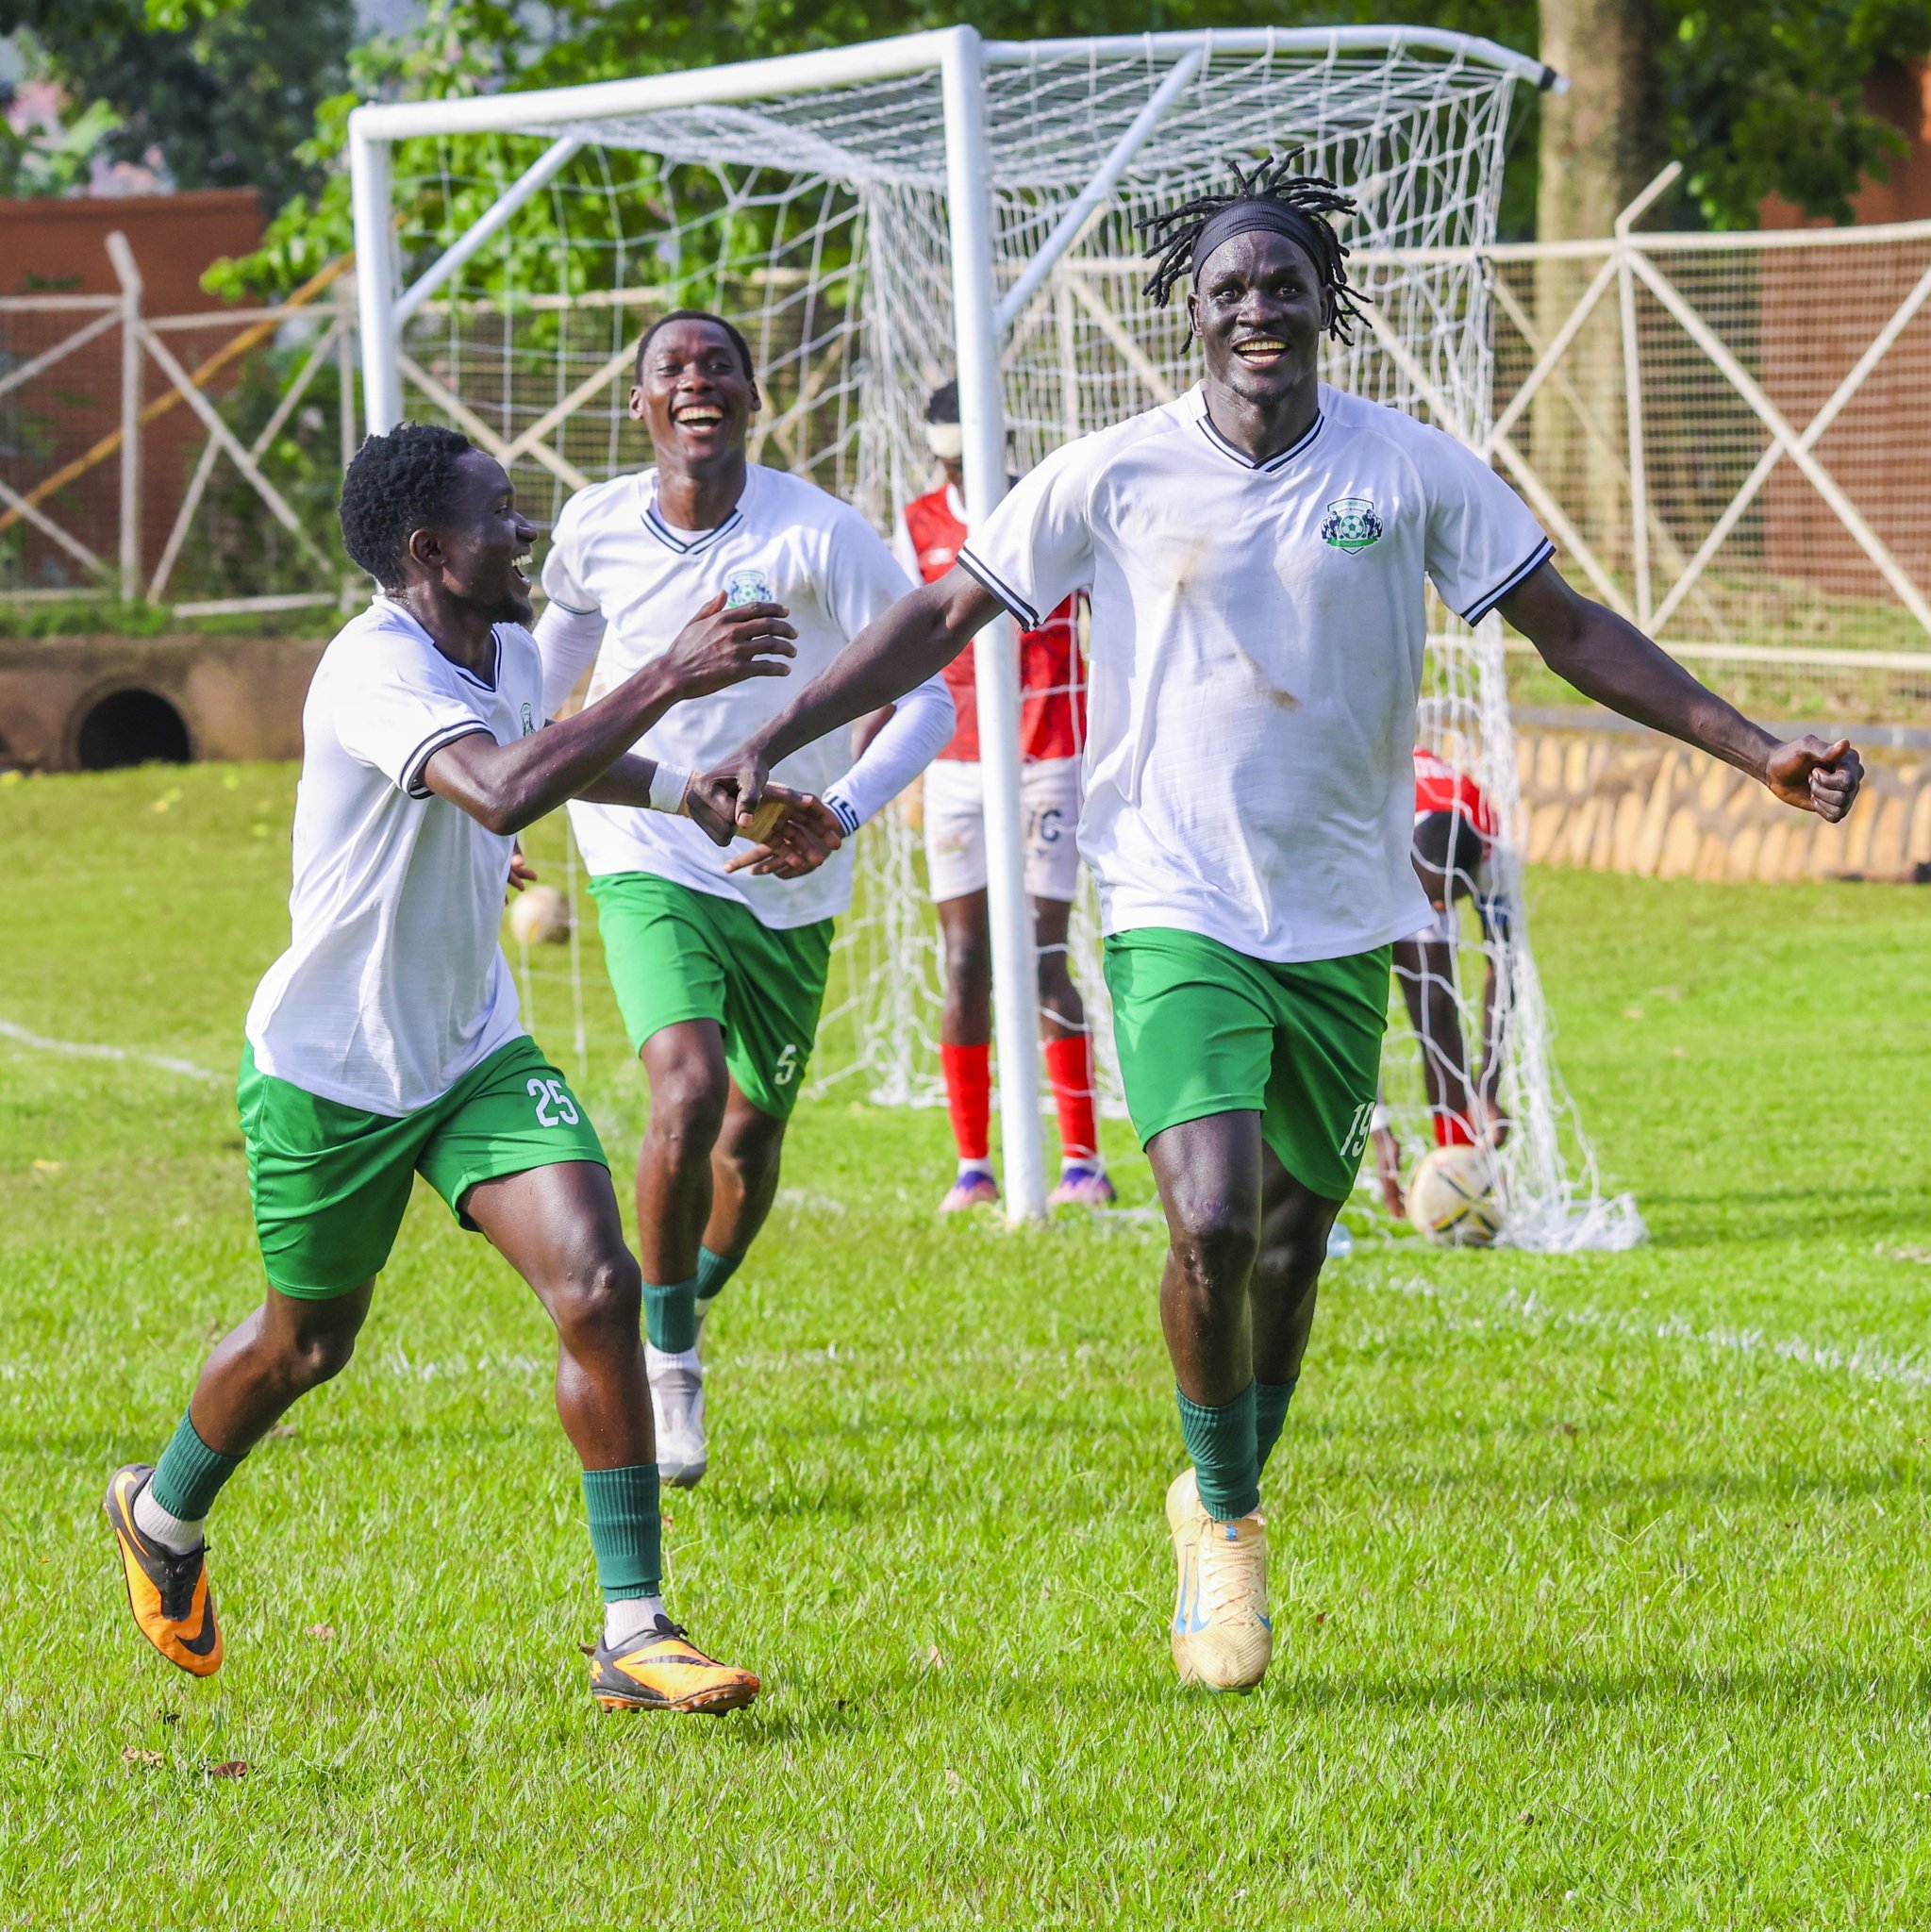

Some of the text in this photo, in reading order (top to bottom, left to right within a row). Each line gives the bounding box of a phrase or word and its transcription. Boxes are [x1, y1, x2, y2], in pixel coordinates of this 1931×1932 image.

[774, 1043, 796, 1085] 5
[526, 1078, 579, 1127] 25
[1340, 1101, 1375, 1158] 19
